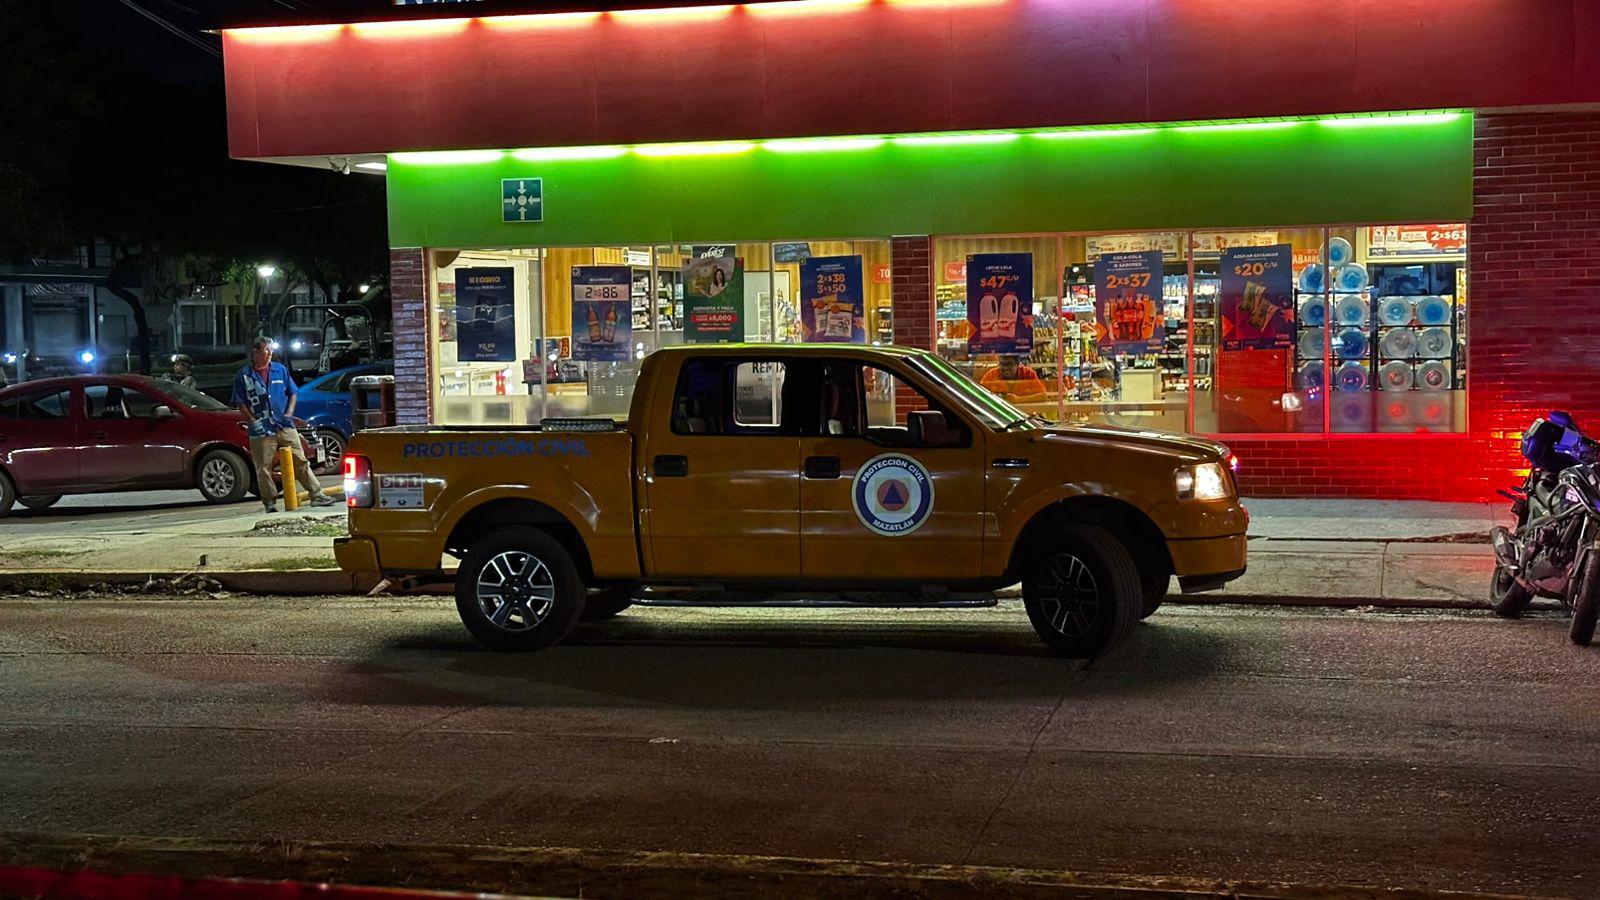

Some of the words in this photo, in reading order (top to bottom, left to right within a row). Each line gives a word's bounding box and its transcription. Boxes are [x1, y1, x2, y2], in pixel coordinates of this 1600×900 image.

[1234, 262, 1265, 276] $20
[980, 275, 1007, 288] $47
[403, 437, 533, 458] PROTECCIÓN
[538, 438, 590, 457] CIVIL
[908, 465, 925, 483] CIVIL
